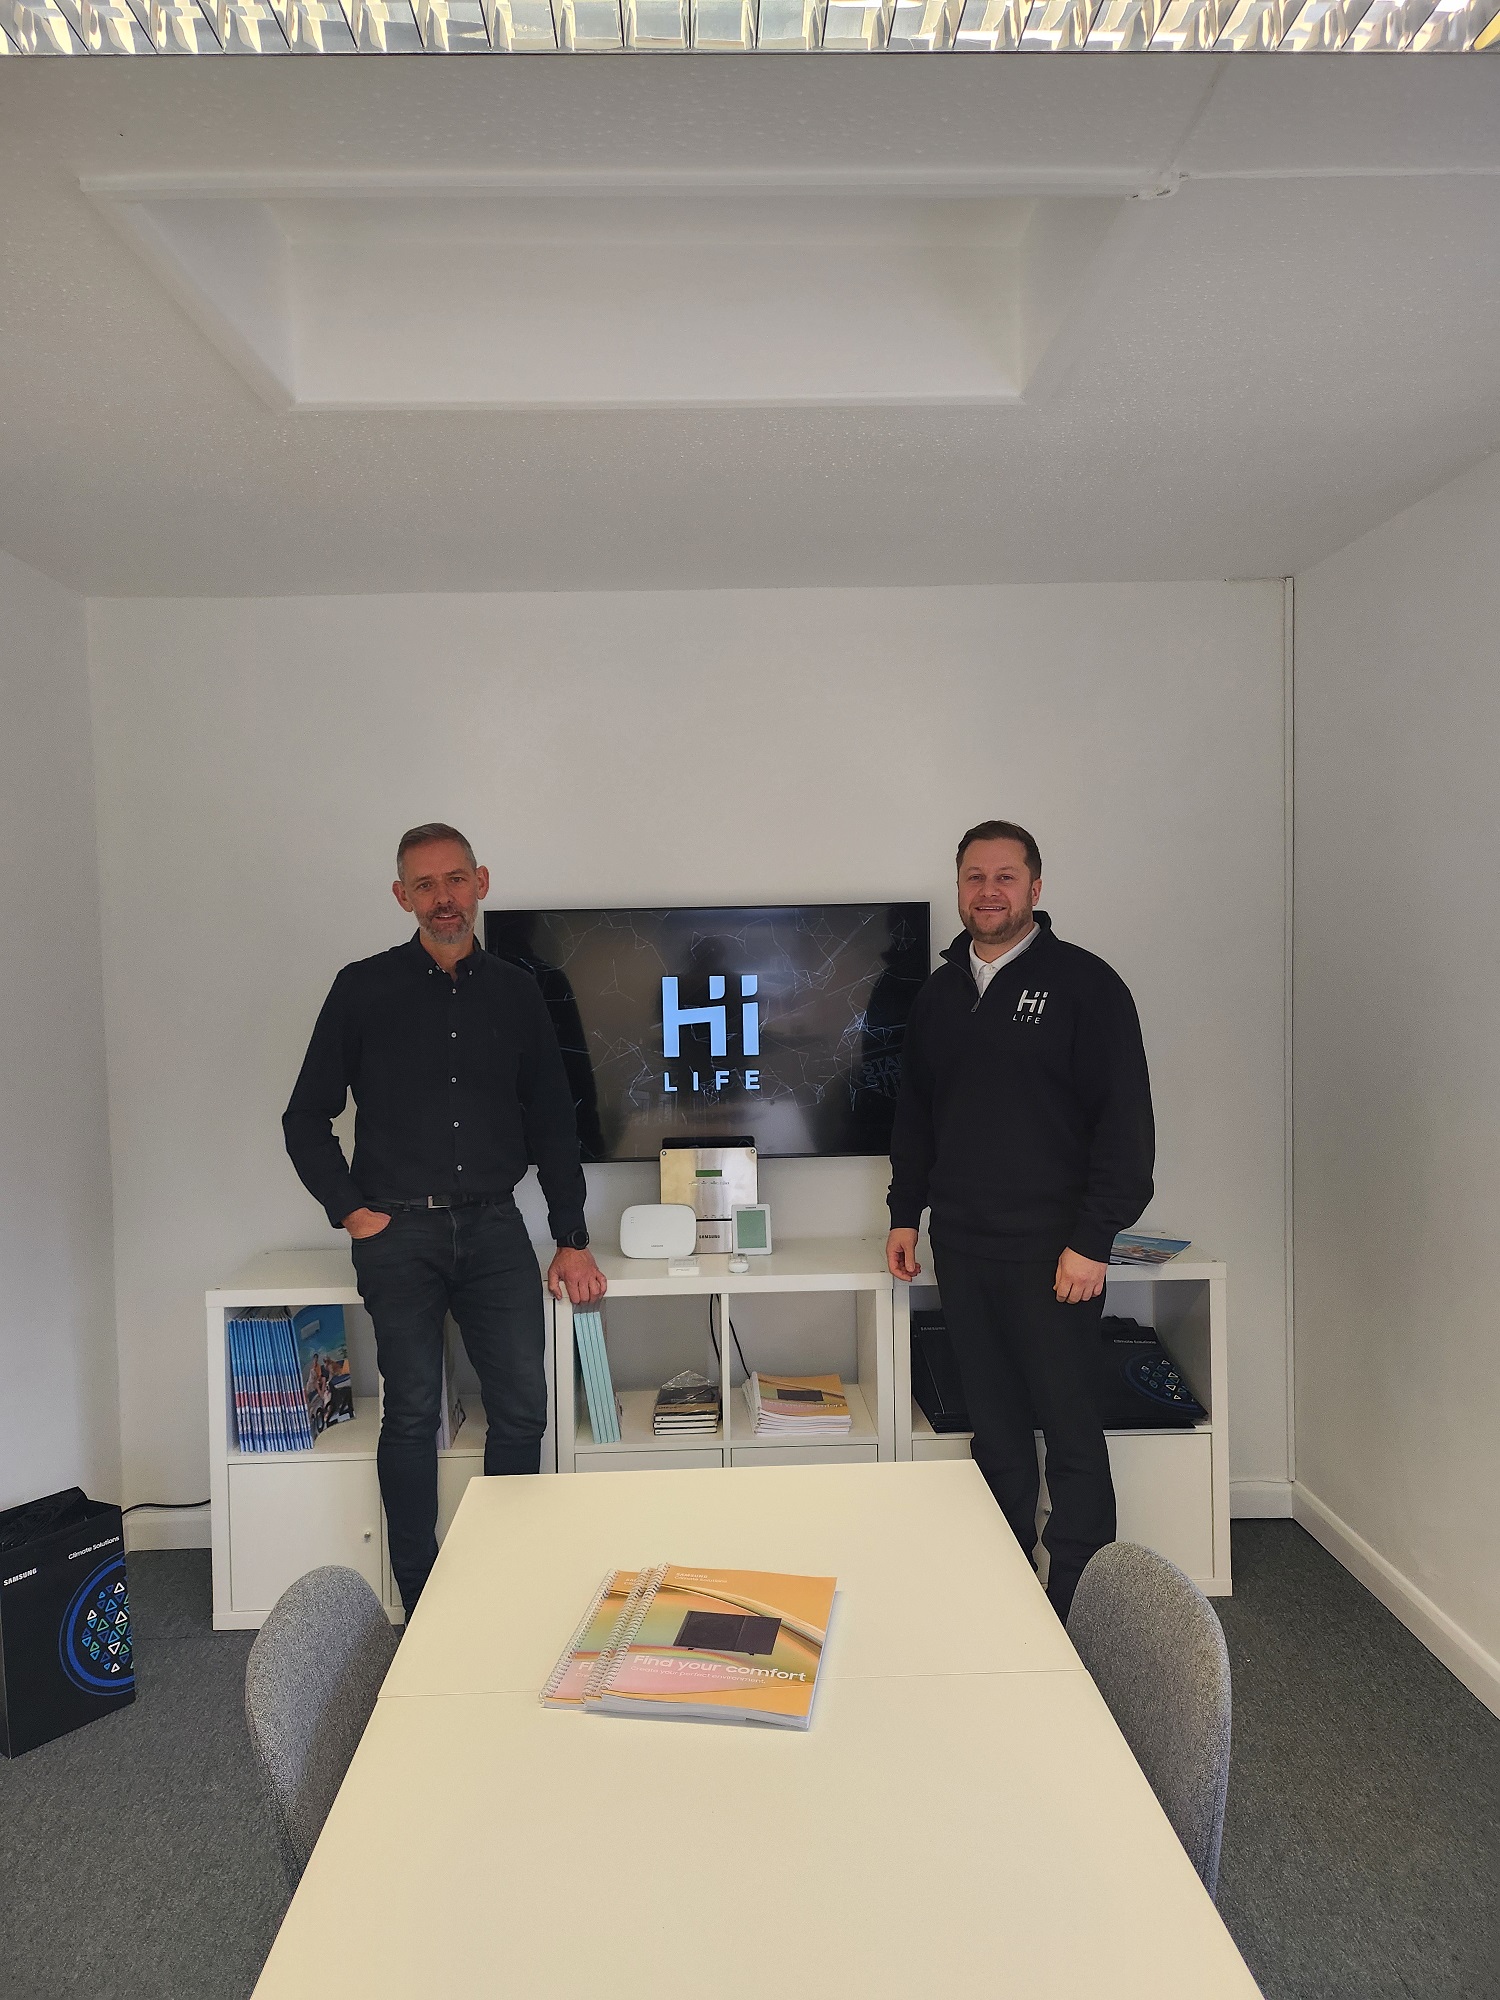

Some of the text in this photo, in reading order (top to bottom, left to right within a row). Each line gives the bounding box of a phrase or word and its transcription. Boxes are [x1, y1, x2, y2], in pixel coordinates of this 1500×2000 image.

[1016, 989, 1049, 1014] Hi
[661, 974, 760, 1058] Hi
[1012, 1014, 1041, 1025] LIFE
[663, 1069, 760, 1092] LIFE
[68, 1535, 120, 1560] Climate Solutions
[3, 1567, 38, 1587] SAMSUNG
[630, 1665, 659, 1673] Create
[679, 1670, 711, 1678] perfect
[711, 1674, 766, 1684] environment.
[633, 1655, 807, 1682] Find your comfort
